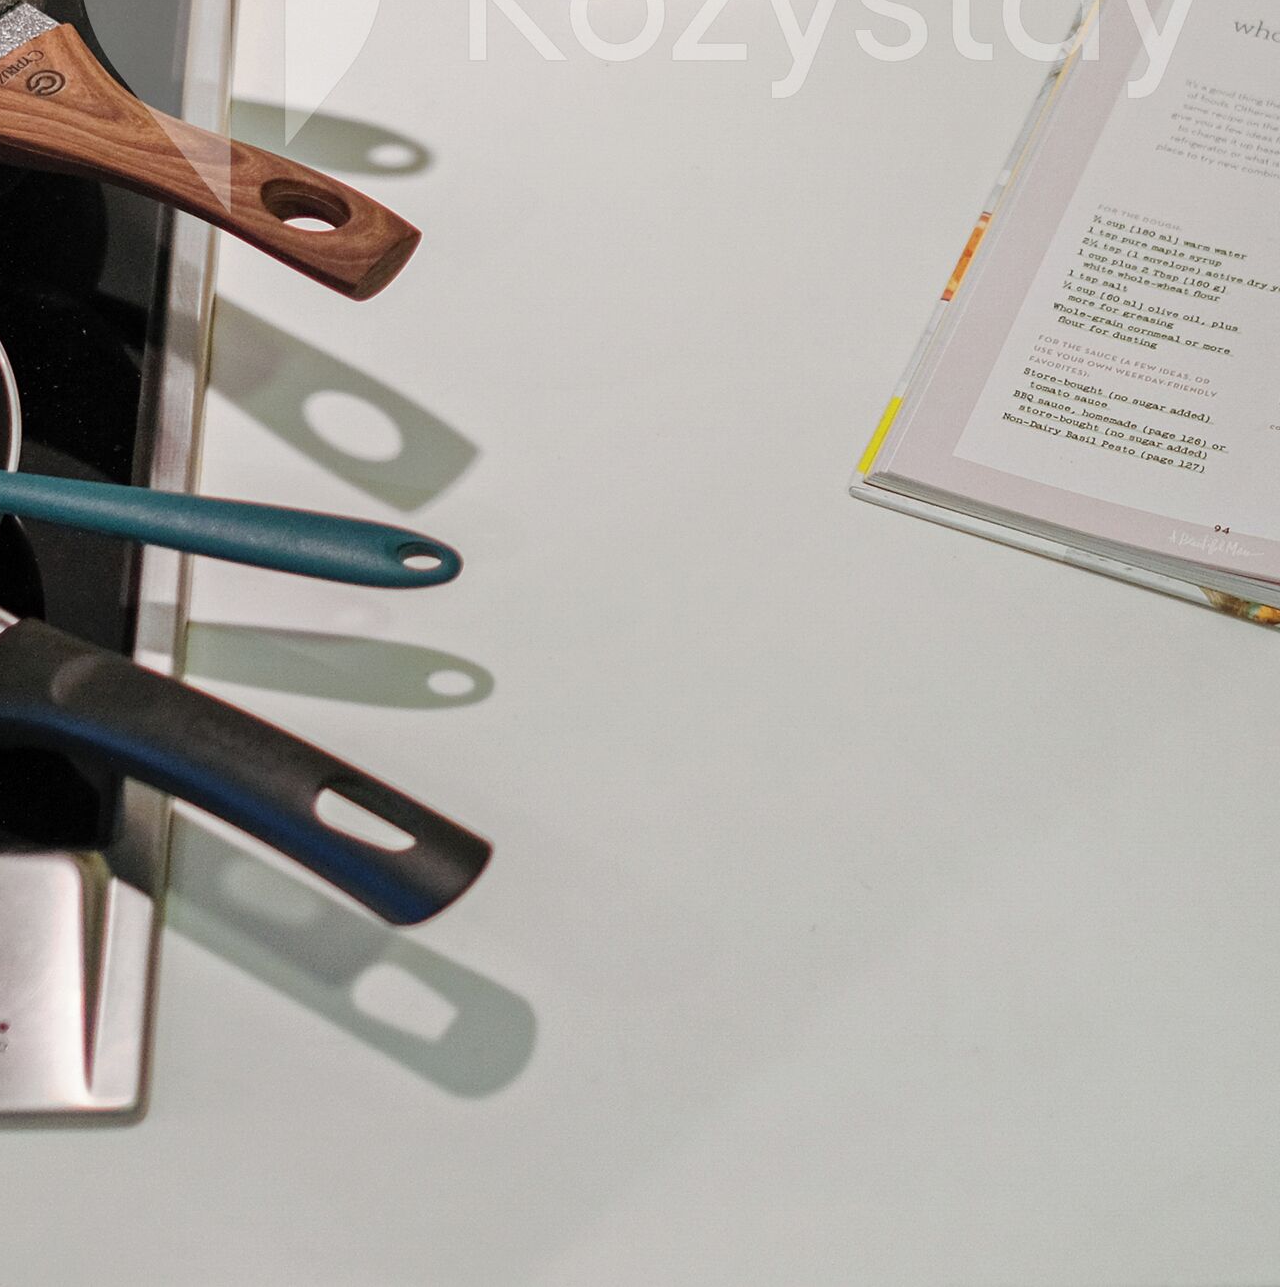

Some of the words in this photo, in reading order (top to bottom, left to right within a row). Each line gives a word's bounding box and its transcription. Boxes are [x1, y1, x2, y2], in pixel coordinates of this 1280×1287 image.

[1098, 228, 1118, 241] tsp
[1119, 236, 1148, 249] pure
[1150, 244, 1186, 258] maple
[1188, 254, 1222, 268] syrup
[1105, 219, 1126, 231] cup
[1157, 234, 1179, 246] ml]
[1182, 240, 1211, 252] warm
[1214, 247, 1248, 260] water
[1078, 272, 1099, 285] tsp
[1101, 280, 1128, 293] salt
[1082, 261, 1114, 276] white
[1117, 271, 1189, 296] whole-wheat
[1192, 289, 1221, 302] flour
[1087, 252, 1109, 264] cup
[1110, 258, 1138, 271] plus
[1151, 268, 1180, 283] Tbsp
[1102, 242, 1122, 255] tsp
[1126, 249, 1139, 259] (1
[1142, 255, 1201, 275] envelope)
[1204, 270, 1244, 284] active
[1246, 278, 1268, 290] dry
[1052, 301, 1124, 330] Whole-grain
[1126, 324, 1181, 344] cornmeal
[1184, 339, 1200, 348] or
[1201, 342, 1231, 355] more
[1066, 294, 1096, 308] more
[1097, 302, 1120, 314] for
[1120, 310, 1175, 330] greasing
[1075, 285, 1096, 297] cup
[1098, 291, 1121, 303] [60
[1122, 298, 1144, 311] ml]
[1146, 305, 1179, 319] olive
[1182, 314, 1206, 326] oil,
[1210, 320, 1239, 332] plus
[1057, 314, 1086, 329] flour
[1088, 324, 1110, 336] for
[1111, 330, 1158, 350] dusting
[1022, 366, 1103, 396] Store-bought
[1107, 390, 1129, 402] (no
[1131, 398, 1167, 412] sugar
[1168, 407, 1211, 424] added)
[1029, 380, 1071, 400] tomato
[1073, 394, 1108, 409] sauce
[1012, 389, 1034, 403] BBQ
[1036, 397, 1076, 415] sauce,
[1080, 408, 1138, 430] homemade
[1142, 425, 1176, 440] (page
[1178, 434, 1207, 449] 126)
[1210, 442, 1227, 452] or
[1017, 404, 1099, 433] store-bought
[1103, 426, 1125, 439] (no
[1128, 434, 1164, 450] sugar
[1165, 444, 1208, 460] added)
[1001, 411, 1062, 436] Non-Dairy
[1064, 429, 1096, 446] Basil
[1099, 439, 1136, 456] Pesto
[1139, 450, 1174, 466] (page
[1176, 459, 1205, 474] 127)
[1214, 524, 1230, 535] 94
